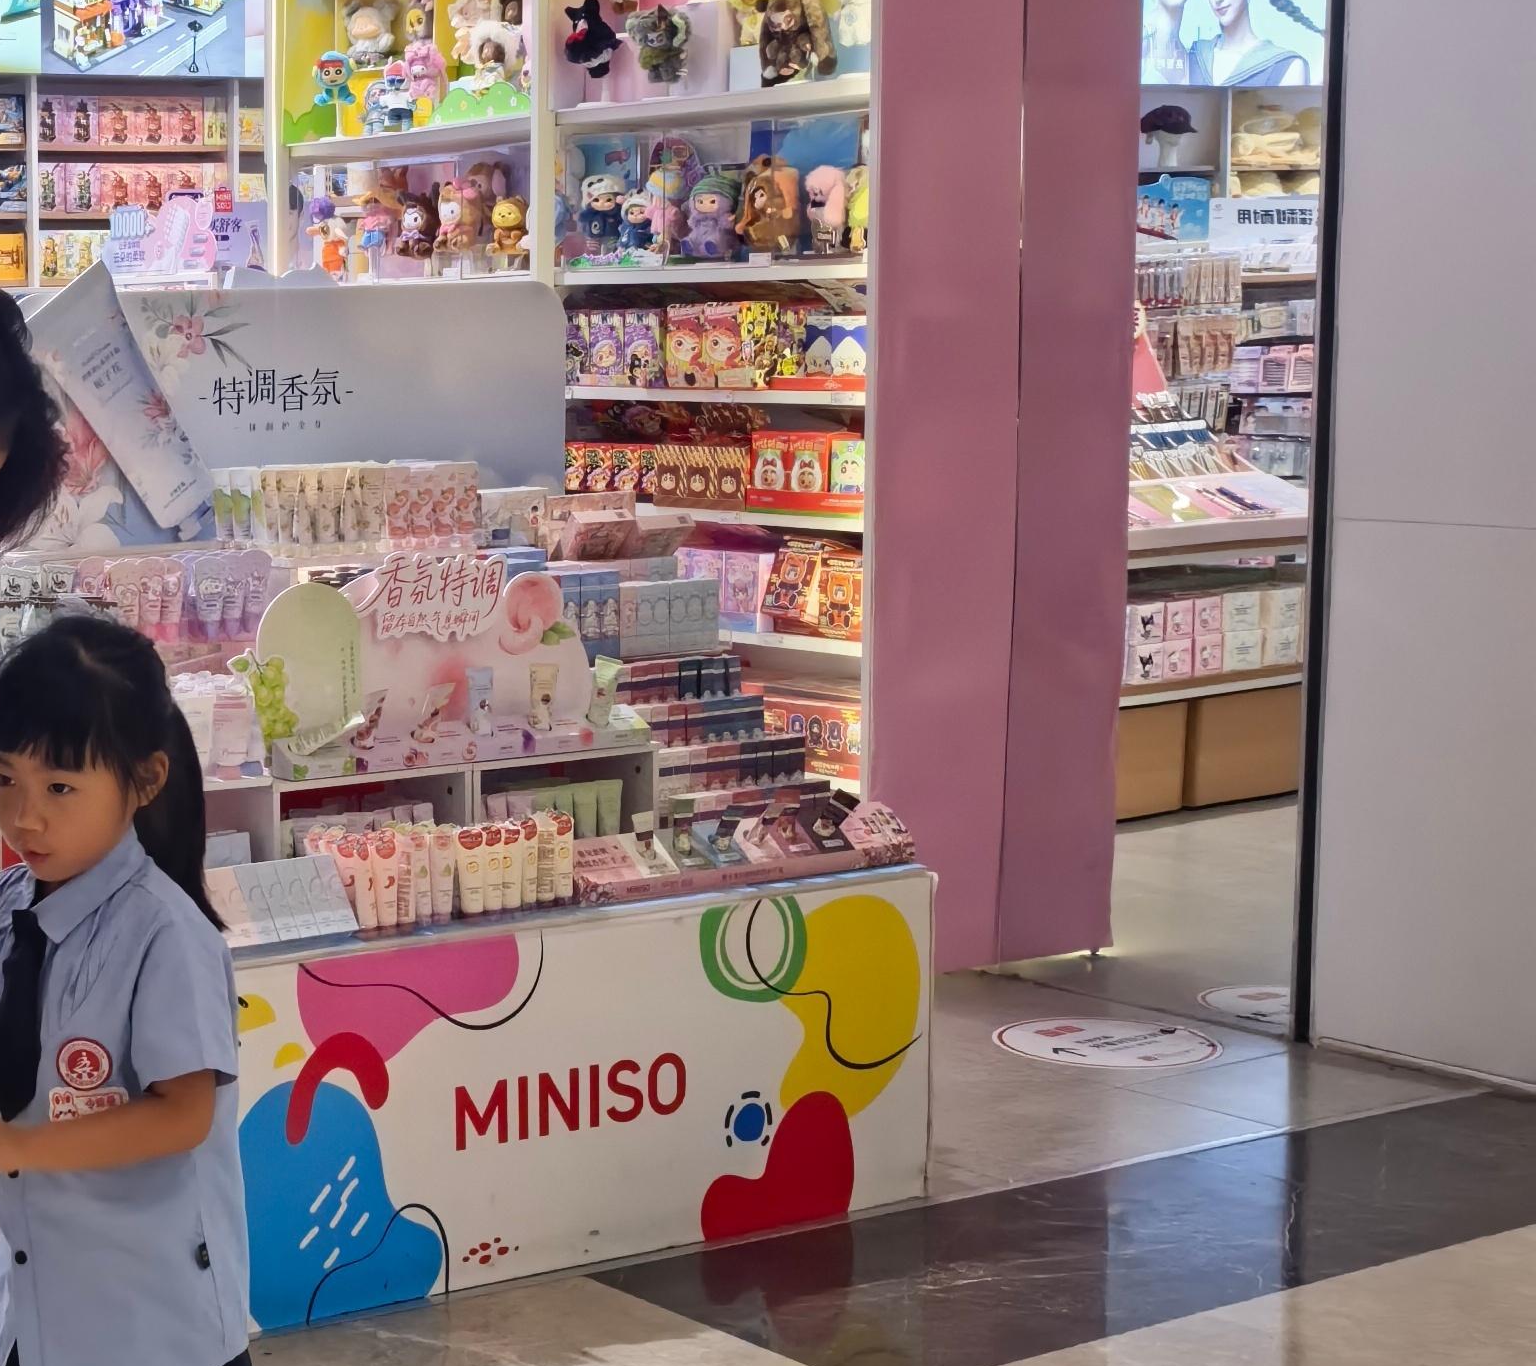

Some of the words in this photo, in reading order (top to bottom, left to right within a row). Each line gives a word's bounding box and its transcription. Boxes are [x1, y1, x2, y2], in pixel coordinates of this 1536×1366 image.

[373, 556, 504, 619] 香氛特调
[455, 1052, 687, 1151] MINISO
